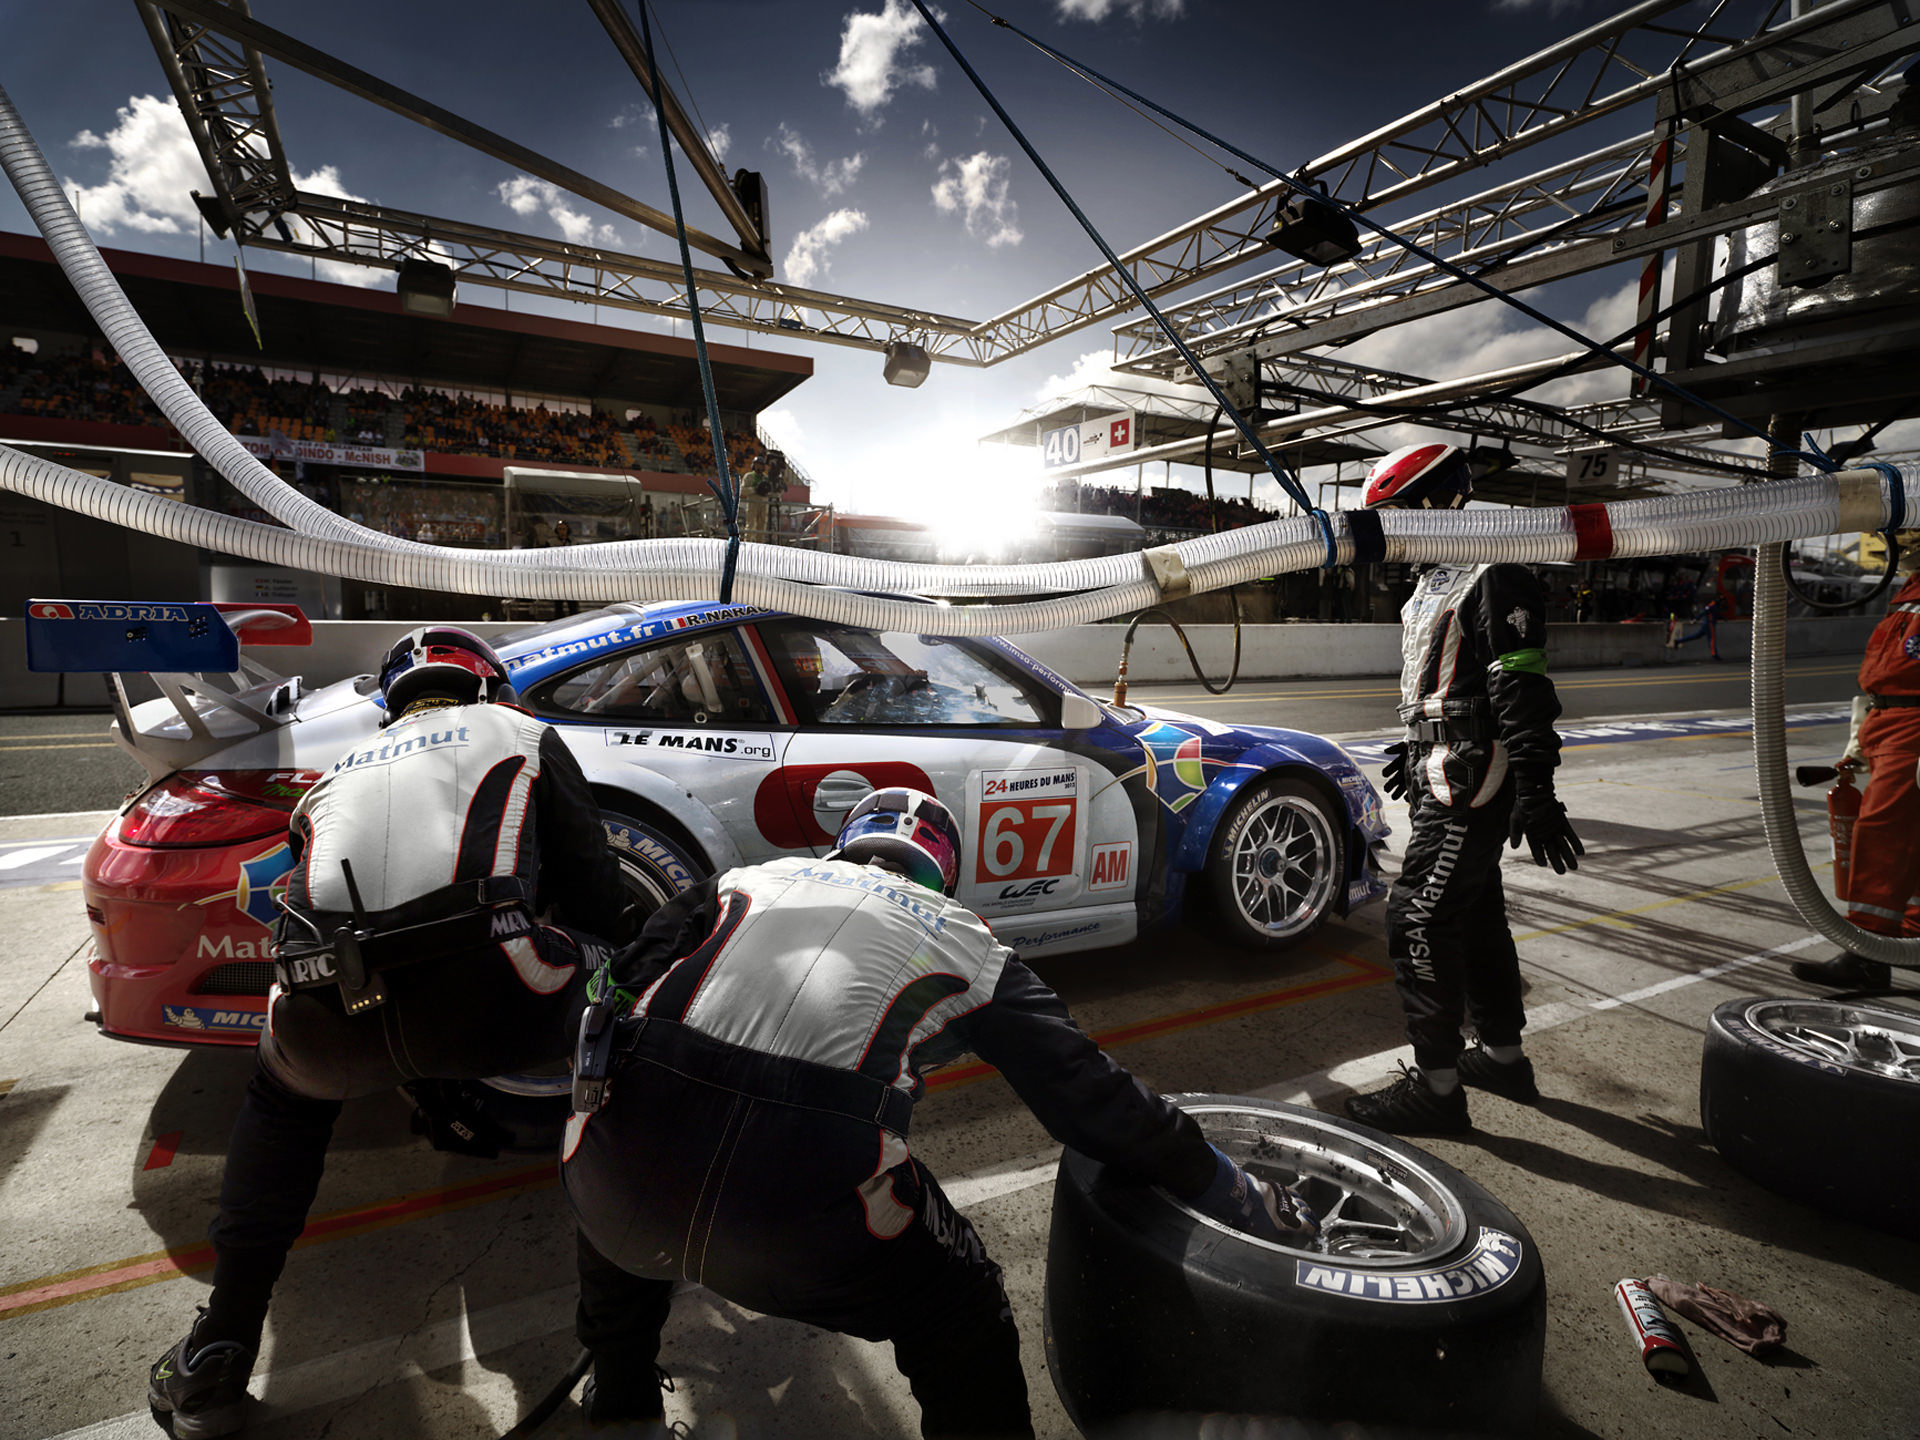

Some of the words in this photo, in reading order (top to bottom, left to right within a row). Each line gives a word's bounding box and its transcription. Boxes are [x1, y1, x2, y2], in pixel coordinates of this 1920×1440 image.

[345, 450, 391, 465] McNISH
[1046, 428, 1079, 465] 40
[1580, 454, 1608, 478] 75
[79, 605, 189, 621] ADRIA
[334, 727, 470, 774] Matmut
[620, 734, 650, 745] LE
[659, 735, 738, 753] MANS
[985, 779, 1008, 795] 24
[1009, 778, 1038, 792] HEURES
[1040, 776, 1051, 787] DU
[1053, 772, 1075, 785] MANS
[1228, 789, 1269, 842] MICHELIN
[983, 805, 1072, 877] 67
[1092, 849, 1128, 884] AM
[999, 879, 1060, 899] WEC
[1013, 922, 1100, 951] Performance
[1304, 1251, 1510, 1300] MICHELIN
